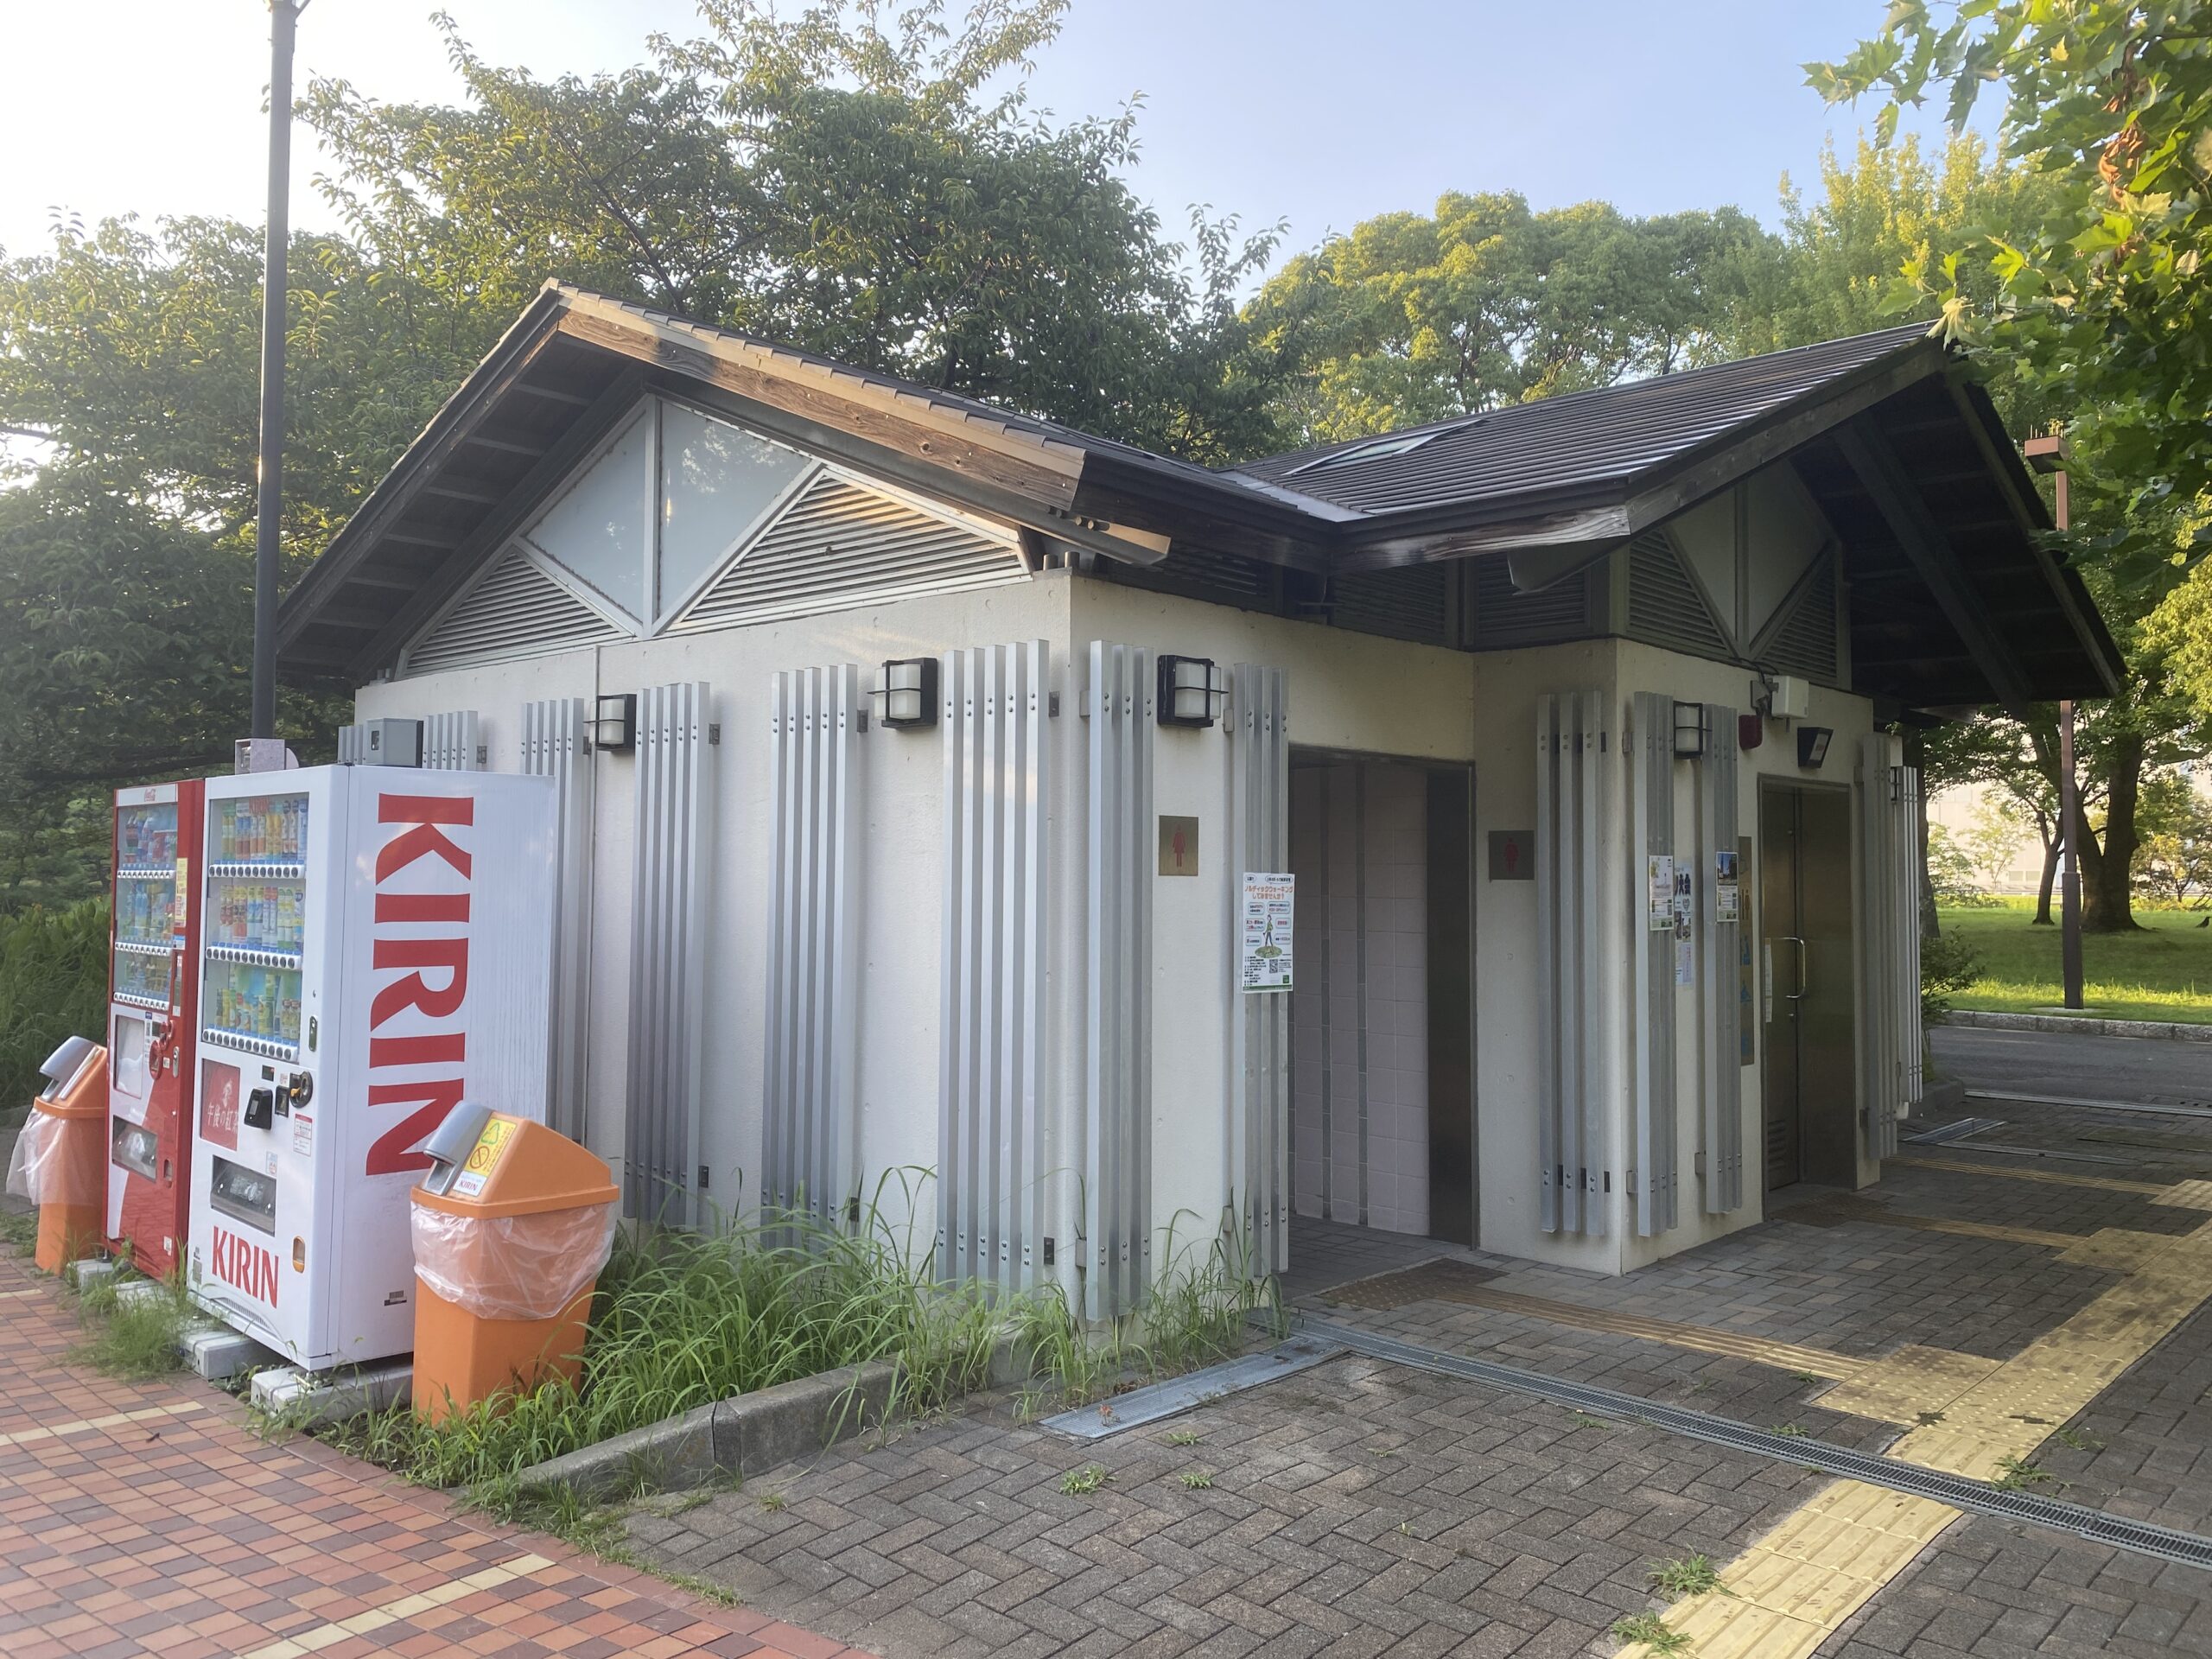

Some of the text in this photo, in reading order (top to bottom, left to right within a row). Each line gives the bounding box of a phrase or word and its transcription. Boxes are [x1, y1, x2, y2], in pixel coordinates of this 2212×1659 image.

[365, 792, 474, 1176] KIRIN
[459, 1180, 478, 1191] KIRIN
[212, 1225, 278, 1309] KIRIN
